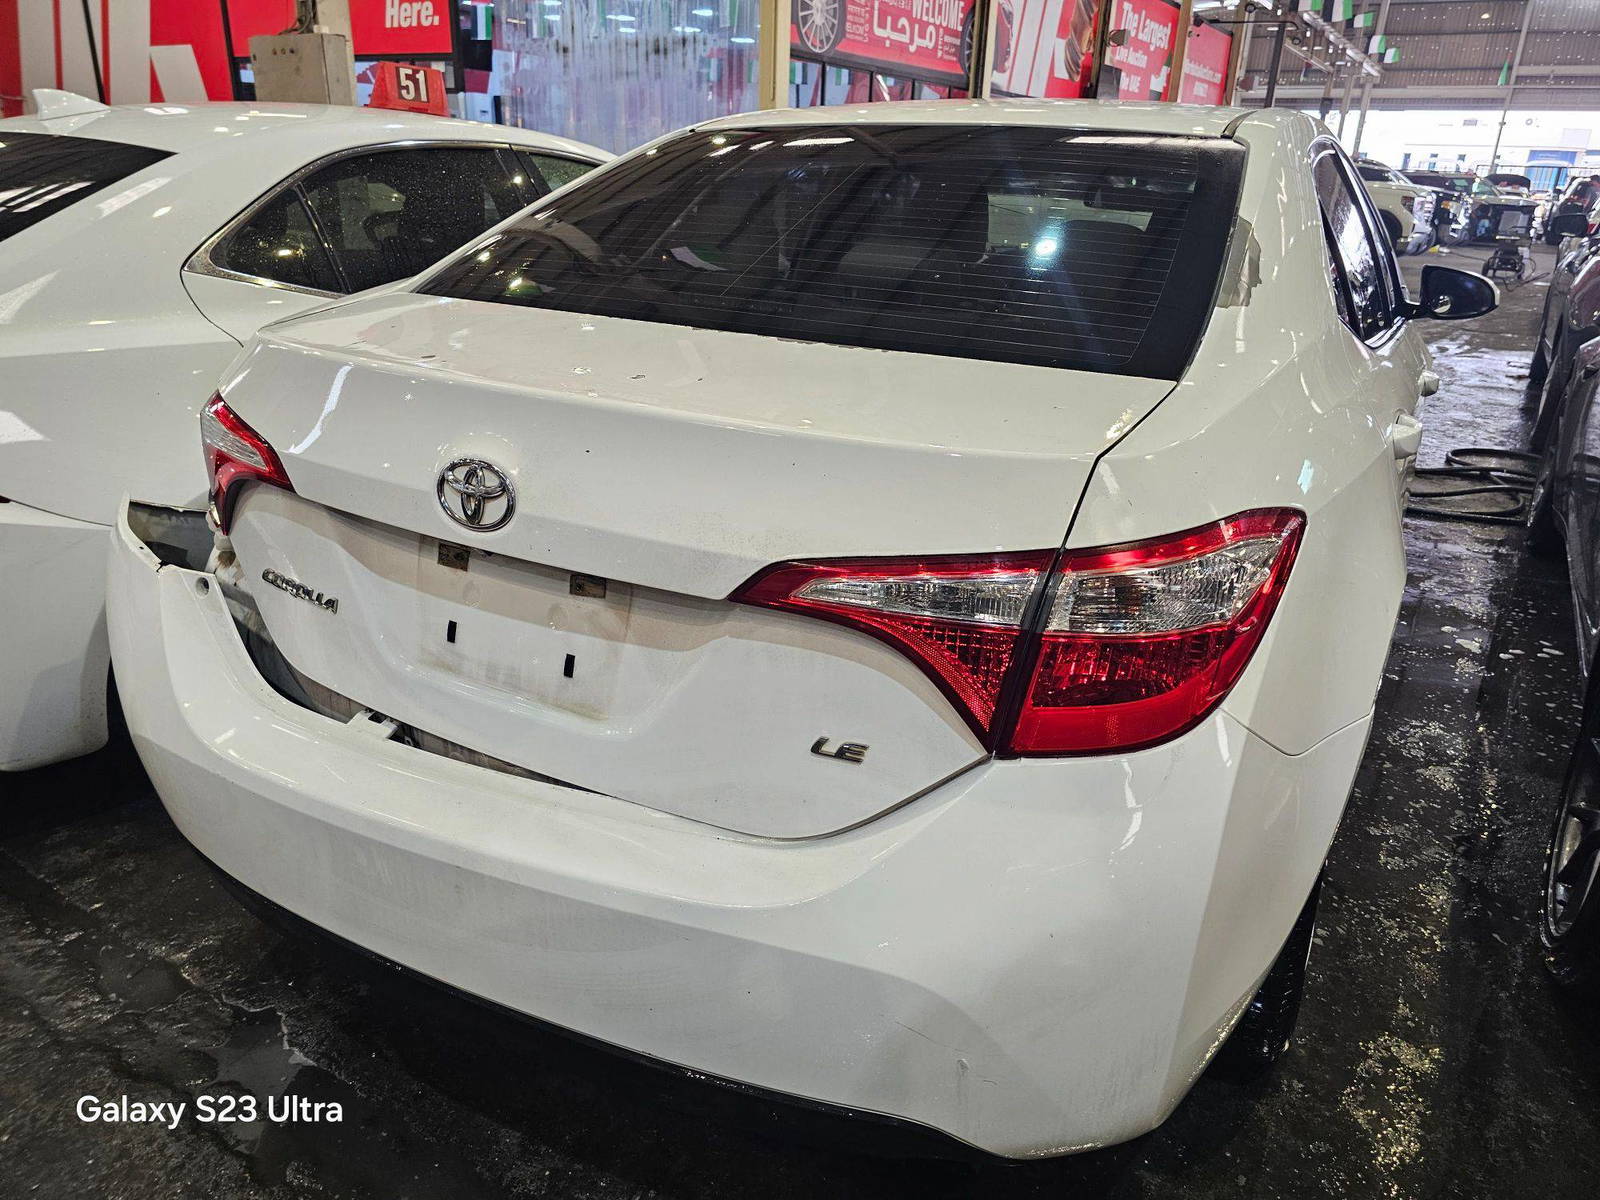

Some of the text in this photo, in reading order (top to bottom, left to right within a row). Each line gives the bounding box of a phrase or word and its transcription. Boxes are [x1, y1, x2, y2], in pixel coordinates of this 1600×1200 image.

[385, 0, 440, 28] Here.
[873, 0, 936, 53] مرحبا
[911, 0, 963, 31] WELCOME
[1121, 1, 1172, 52] The Largest
[399, 66, 428, 102] 51
[262, 568, 339, 615] COROLLA
[810, 736, 869, 764] LE
